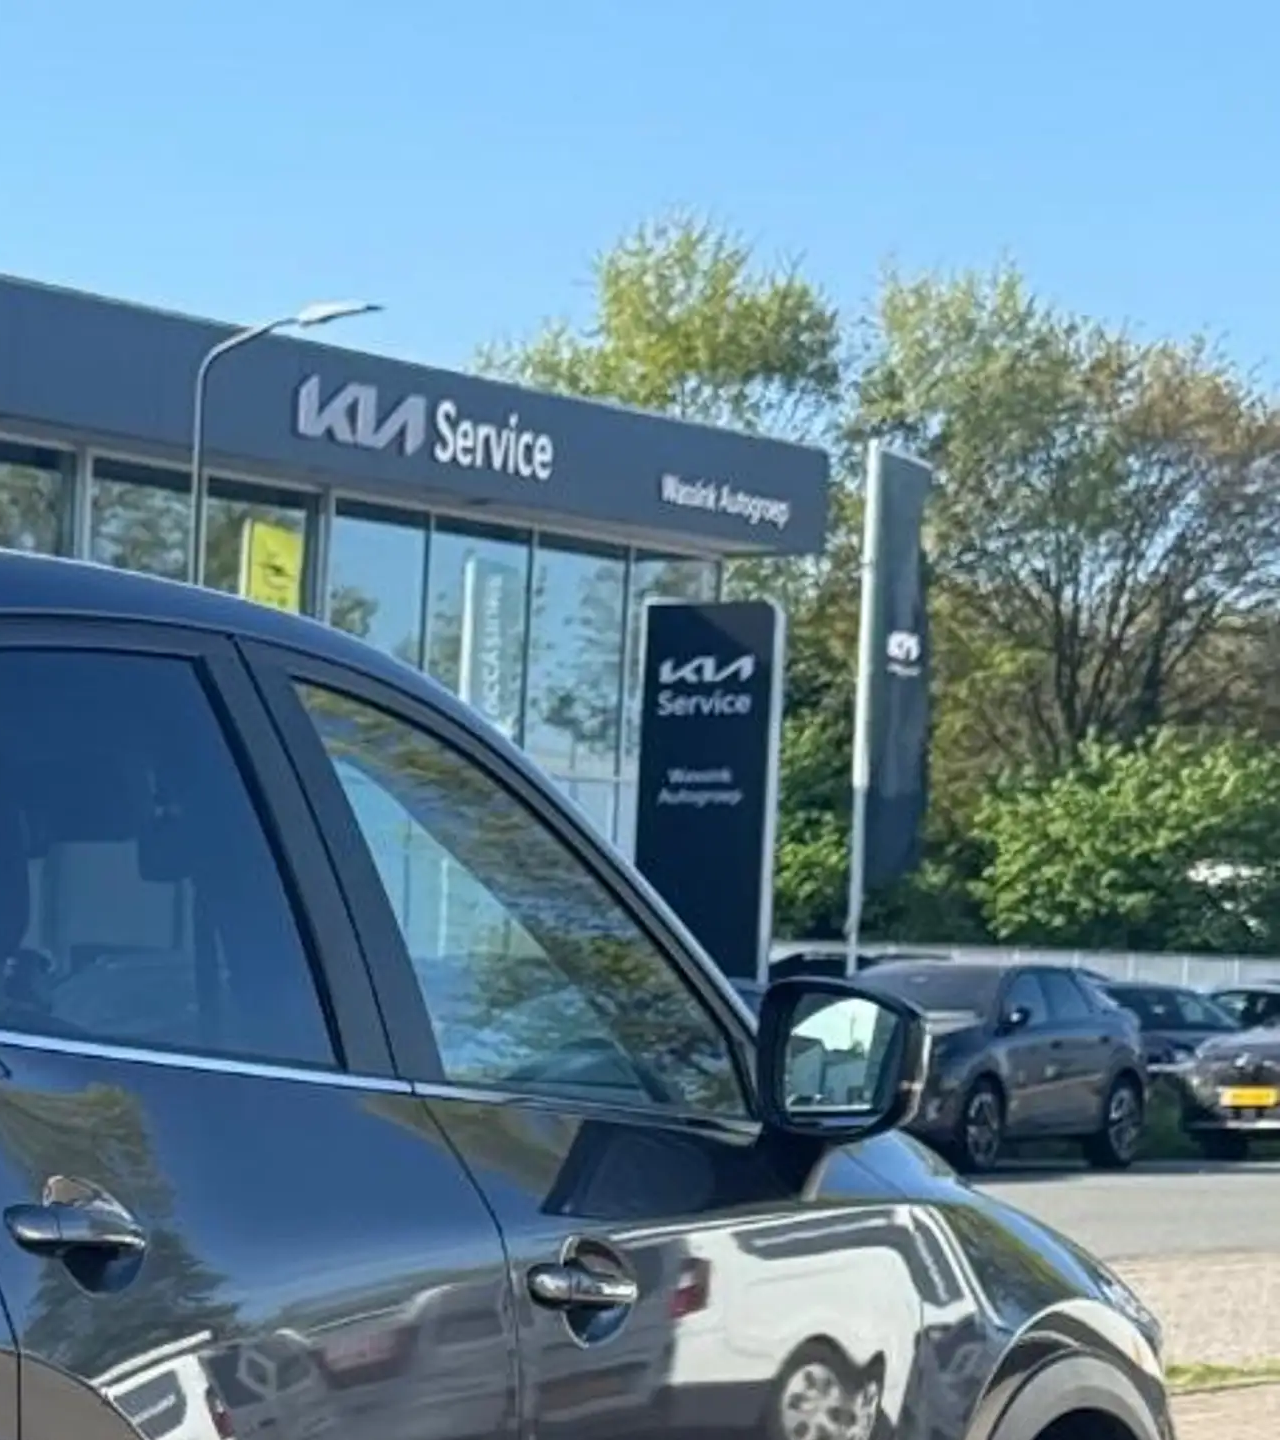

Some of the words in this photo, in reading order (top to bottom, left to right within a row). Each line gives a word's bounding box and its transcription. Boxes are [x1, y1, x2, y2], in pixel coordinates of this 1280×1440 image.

[297, 373, 427, 457] KIA
[434, 399, 554, 481] Service
[658, 653, 757, 685] KIA
[656, 688, 753, 717] Service
